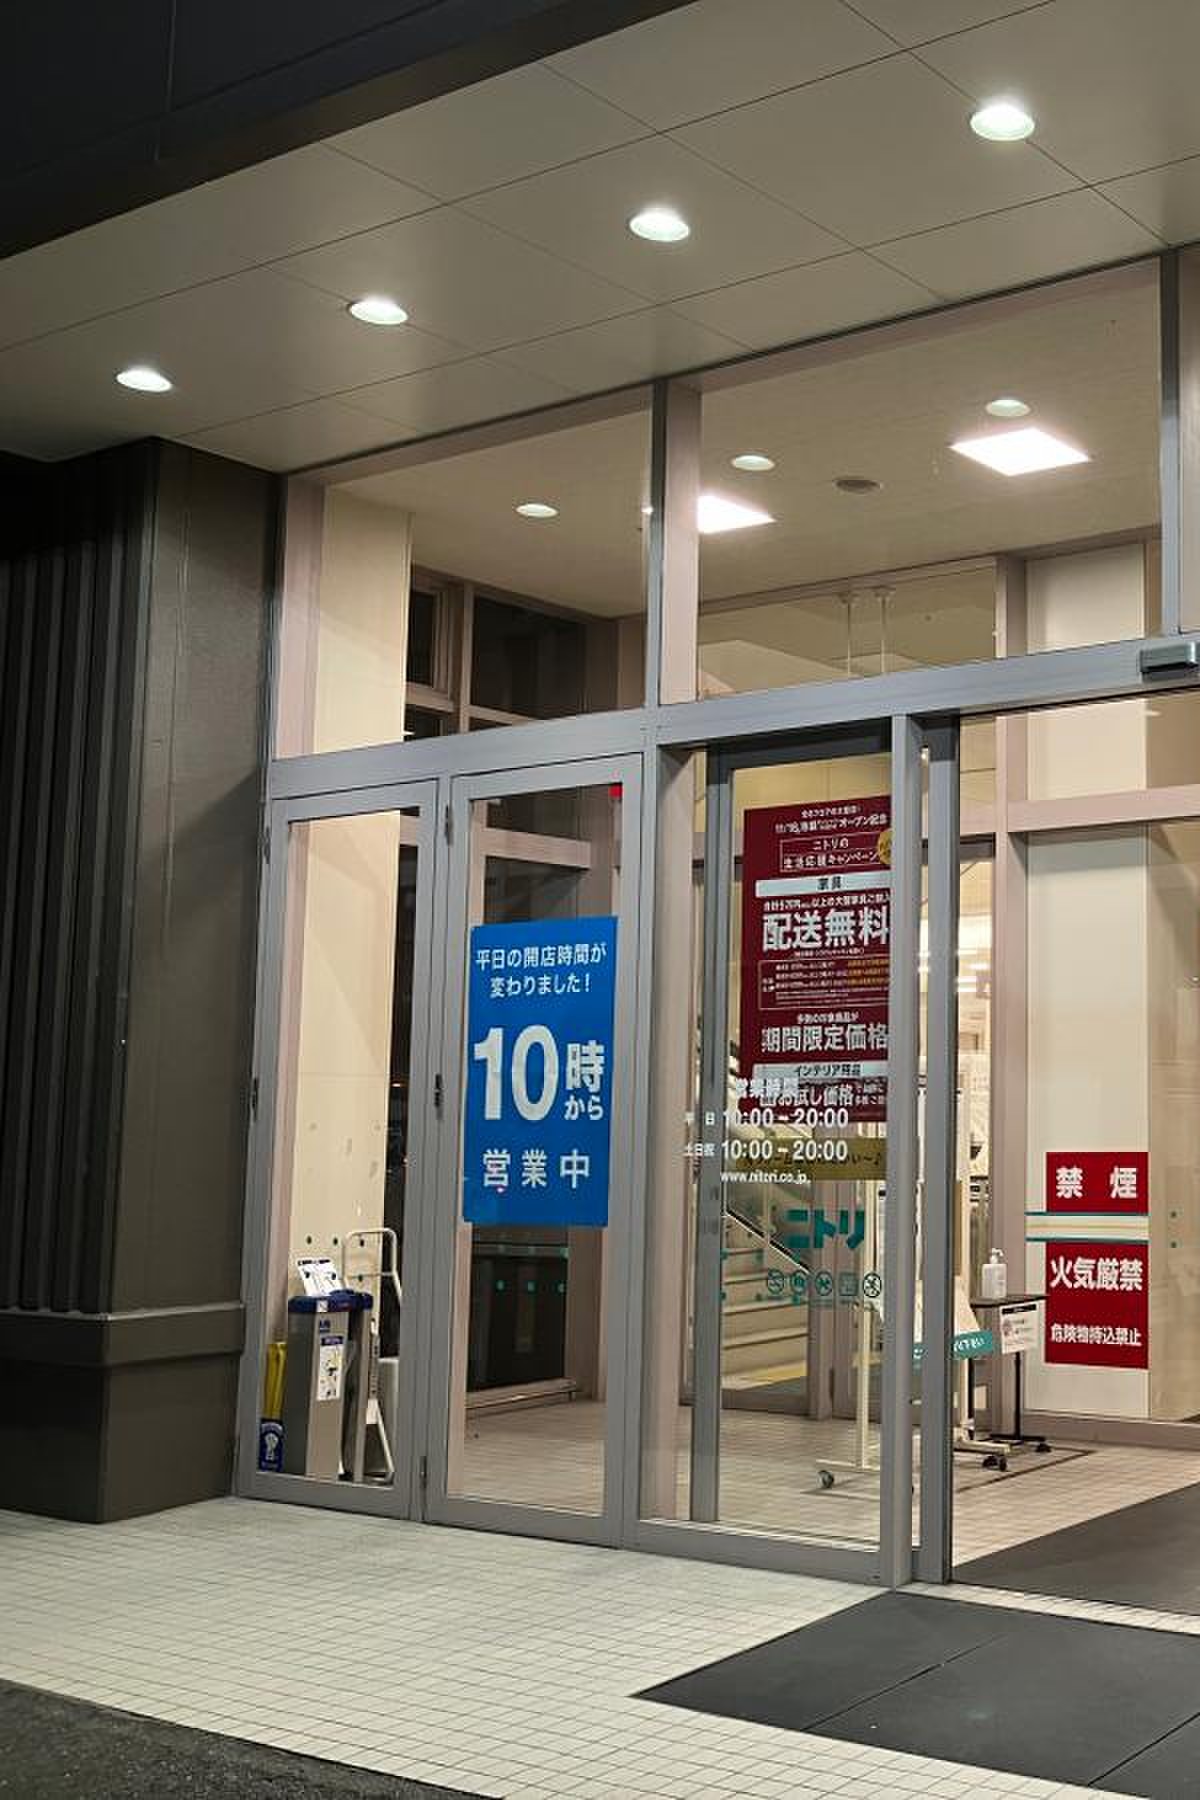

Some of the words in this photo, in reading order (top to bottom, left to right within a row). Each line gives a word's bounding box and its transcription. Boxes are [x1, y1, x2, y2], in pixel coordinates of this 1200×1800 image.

[762, 904, 889, 952] 配送無料
[476, 942, 607, 971] 平日の開店時間が
[489, 972, 591, 998] 変わりました!
[760, 1021, 888, 1053] 期間限定価格
[794, 1107, 849, 1128] 20:00
[720, 1139, 774, 1160] 10:00
[793, 1139, 849, 1160] 20:00
[482, 1148, 591, 1189] 営業中
[1056, 1164, 1139, 1199] 禁煙
[786, 1208, 865, 1250] ニトリ
[1050, 1256, 1144, 1291] 火気厳禁
[1050, 1322, 1142, 1348] 危険物持込禁止
